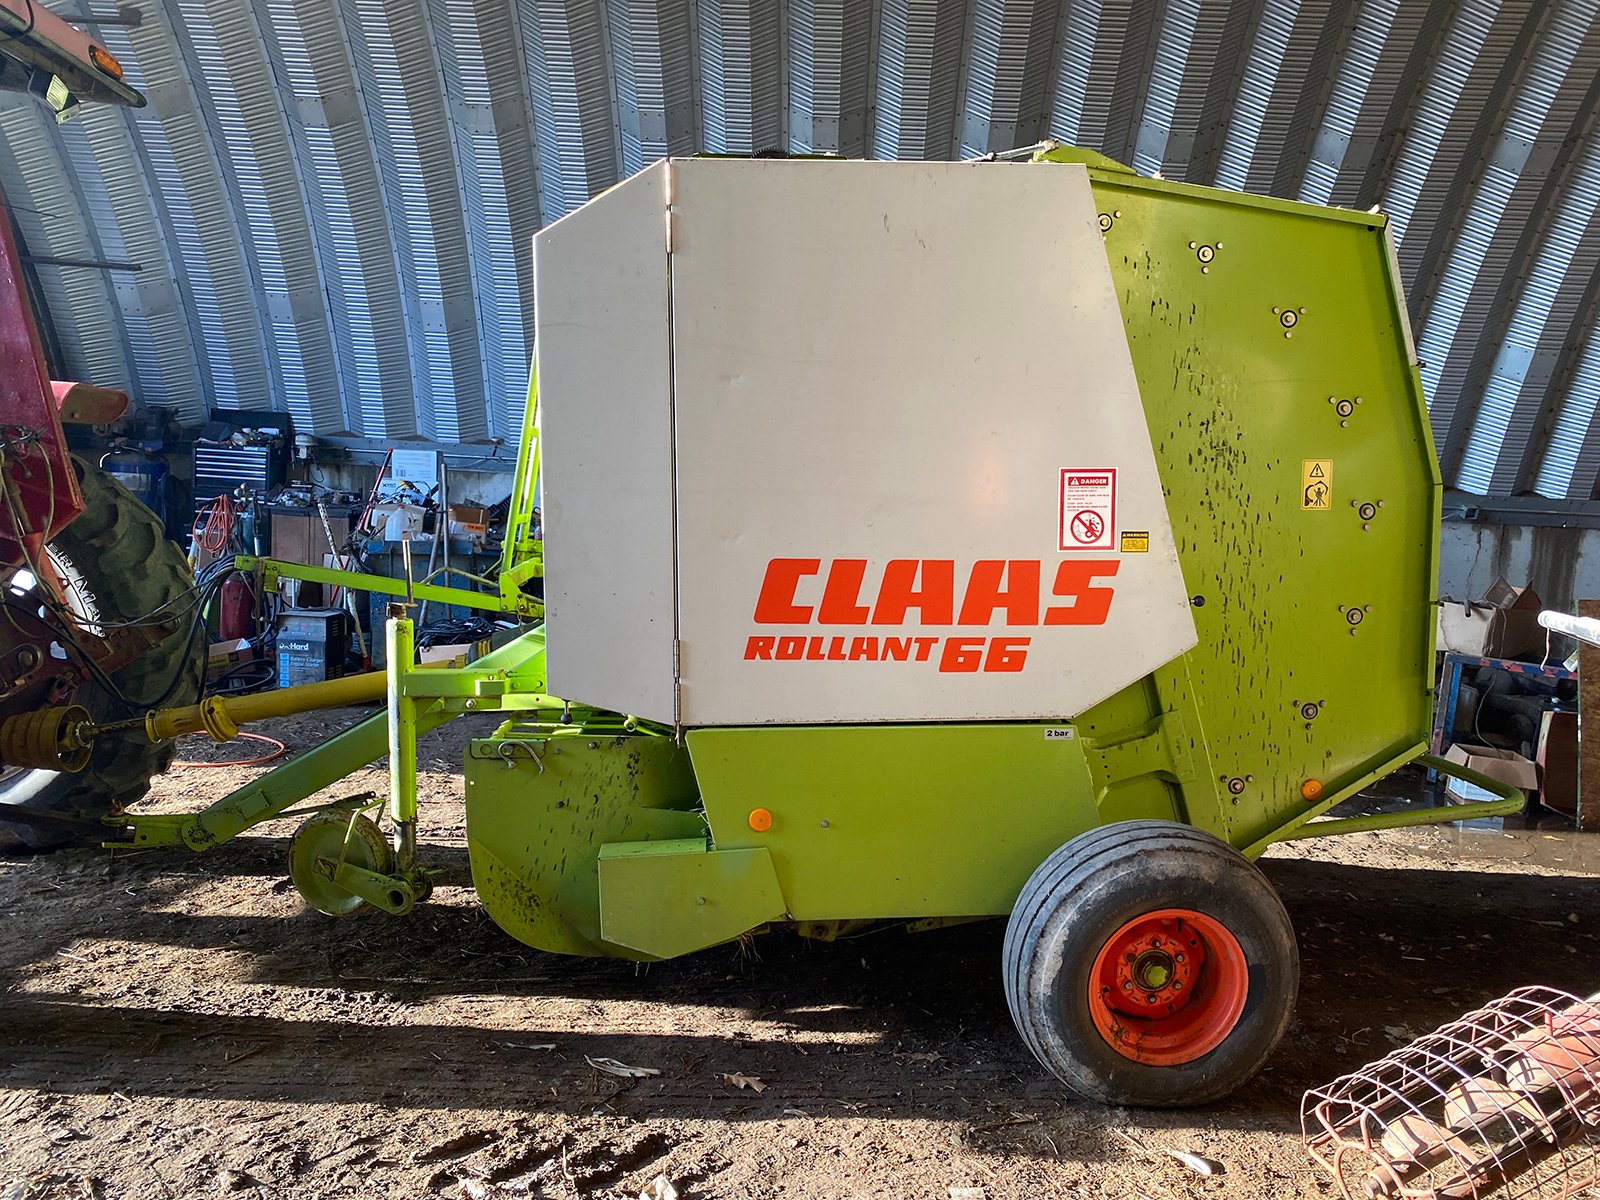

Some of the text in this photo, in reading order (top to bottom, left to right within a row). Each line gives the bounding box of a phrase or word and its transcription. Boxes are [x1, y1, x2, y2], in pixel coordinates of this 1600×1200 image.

[753, 558, 1121, 625] CLAAS
[743, 636, 1031, 672] ROLLANT 66
